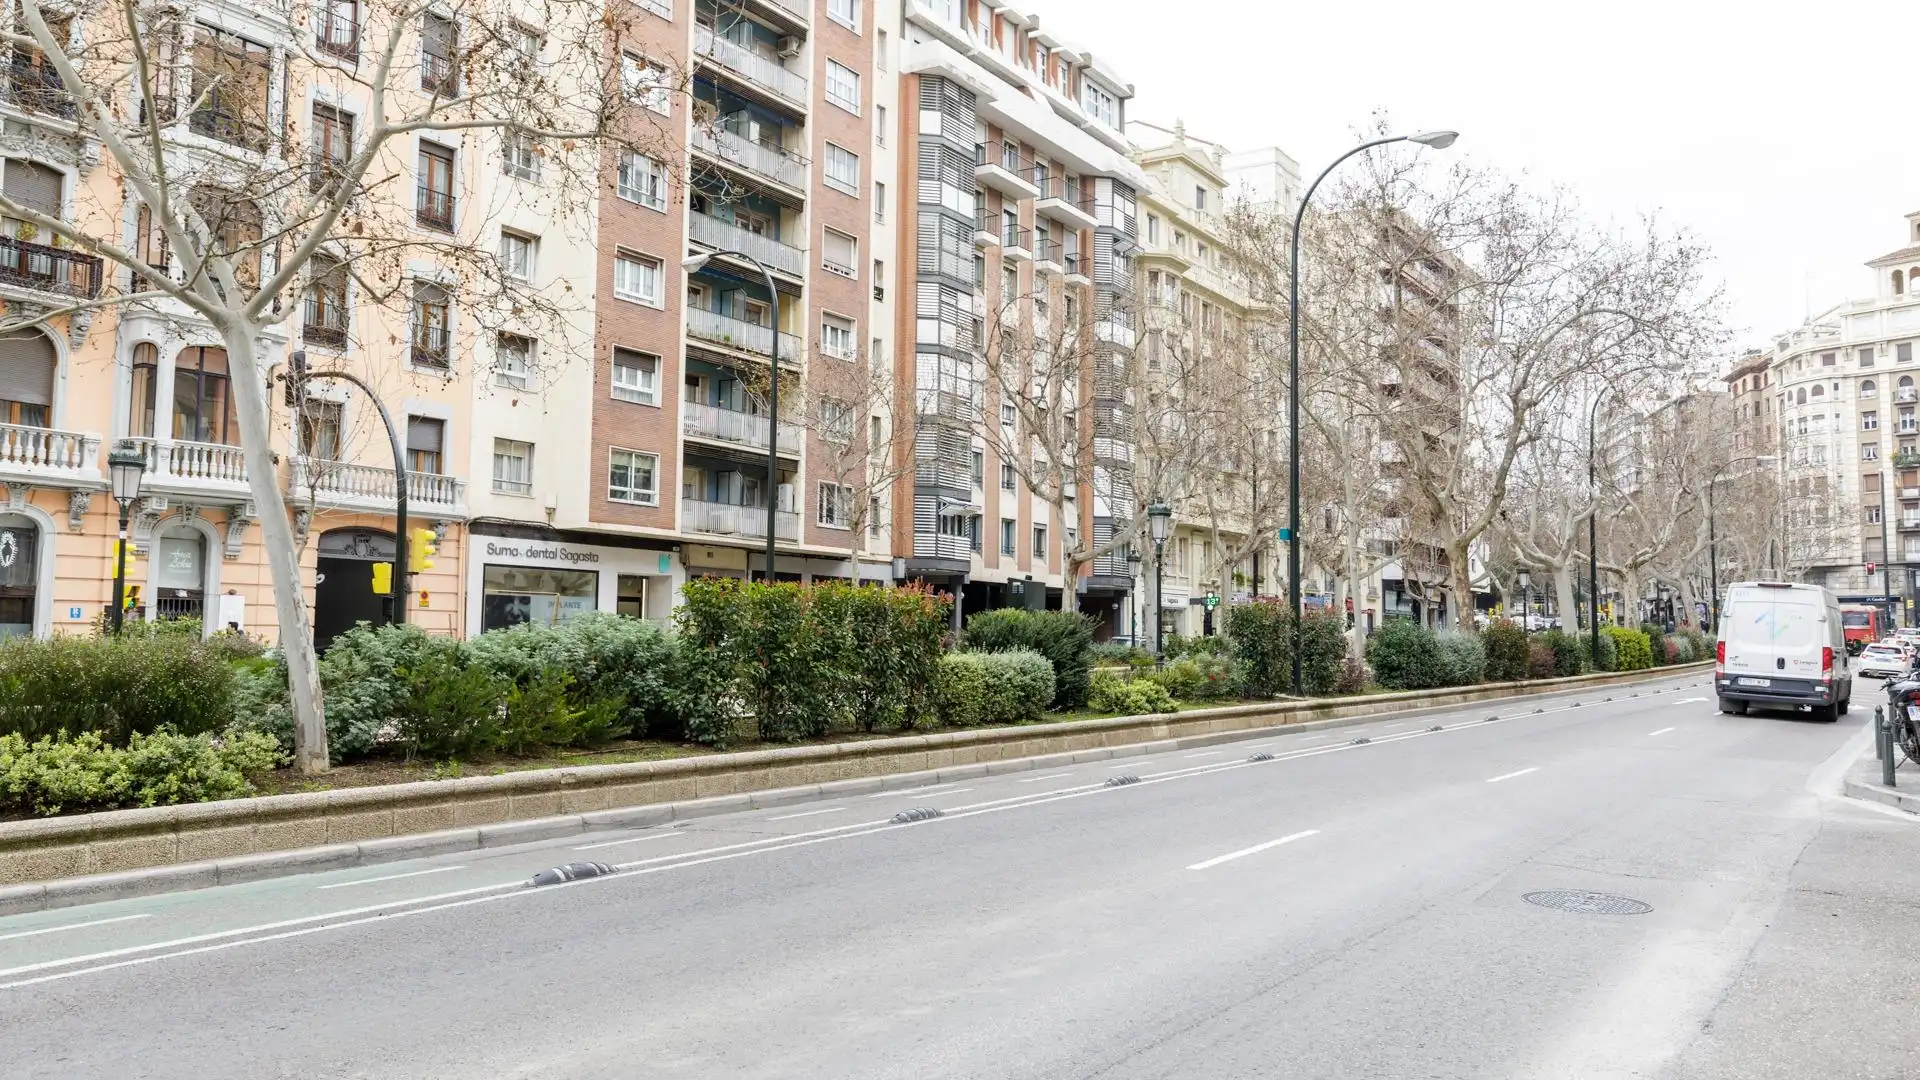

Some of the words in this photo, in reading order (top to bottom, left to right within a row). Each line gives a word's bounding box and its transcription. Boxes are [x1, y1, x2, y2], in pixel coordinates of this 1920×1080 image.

[486, 542, 519, 558] Suma
[525, 545, 558, 560] dental
[559, 547, 600, 565] Sagasta
[547, 600, 583, 609] IMLANTE
